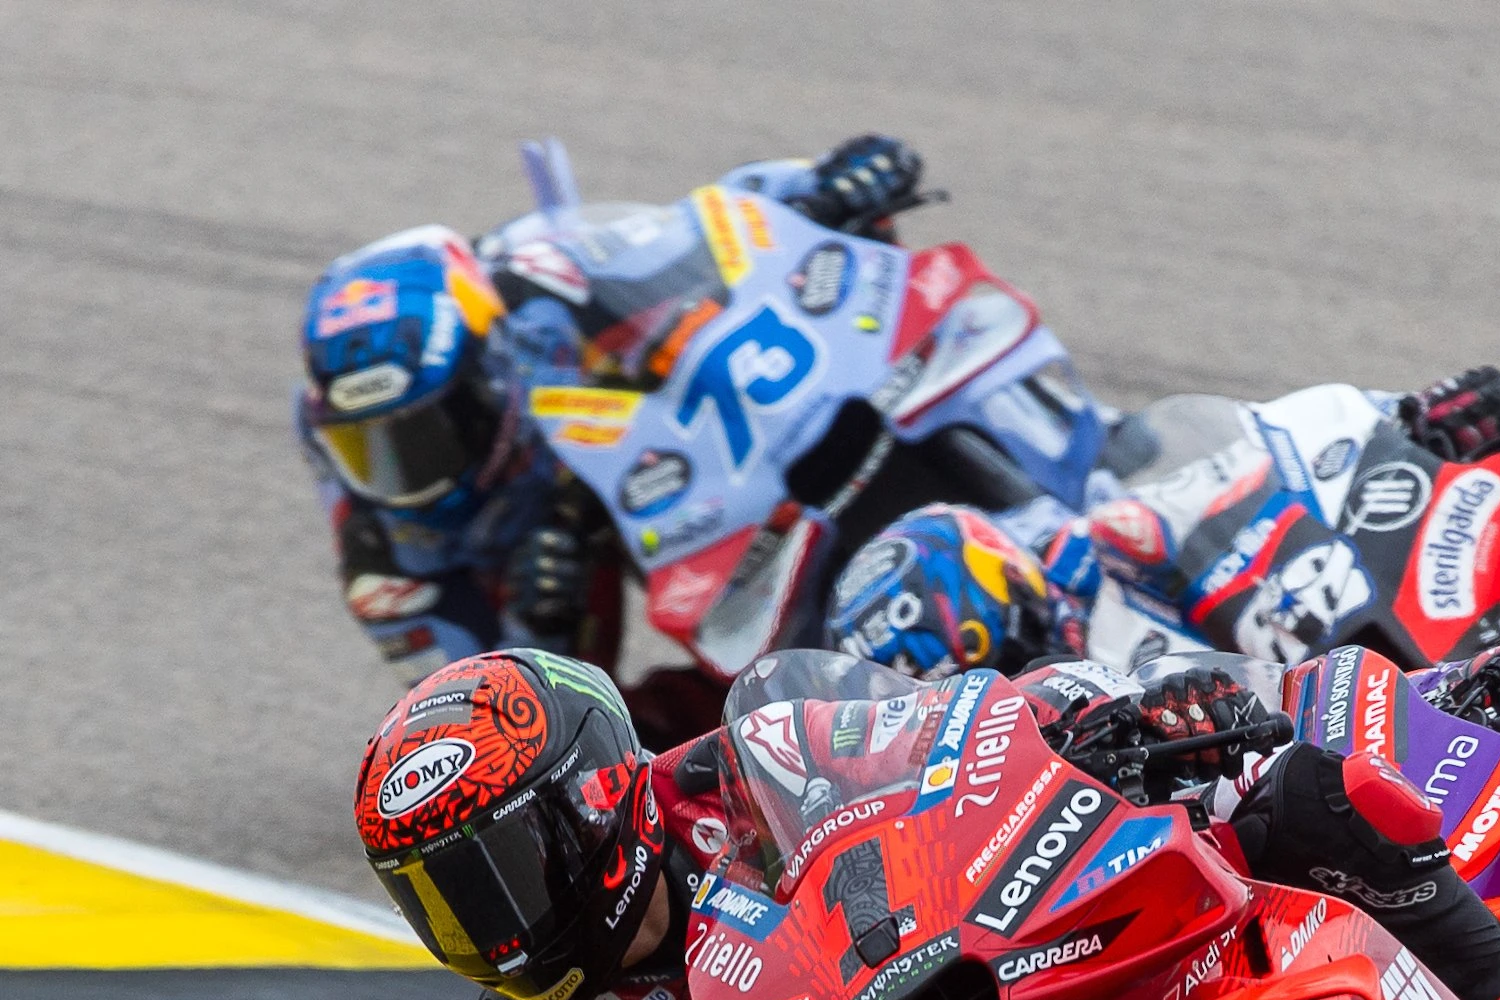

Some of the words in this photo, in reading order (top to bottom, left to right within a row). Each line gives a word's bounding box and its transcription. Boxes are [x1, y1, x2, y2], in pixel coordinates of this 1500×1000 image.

[676, 306, 817, 468] 73
[1427, 479, 1495, 609] sterilgarda
[410, 692, 465, 713] Lenovo
[938, 674, 988, 752] ADVANCE
[966, 696, 1025, 787] riello
[382, 752, 463, 805] SUOMY
[493, 788, 537, 821] CARRERA
[787, 800, 886, 879] VARGROUP
[965, 761, 1062, 884] FRECCIAROSSA
[975, 787, 1102, 932] Lenovo
[1108, 837, 1163, 874] TIM
[605, 845, 648, 929] Lenovo
[707, 889, 769, 925] ADVANCE
[694, 931, 763, 992] riello
[998, 934, 1103, 981] CARRERA
